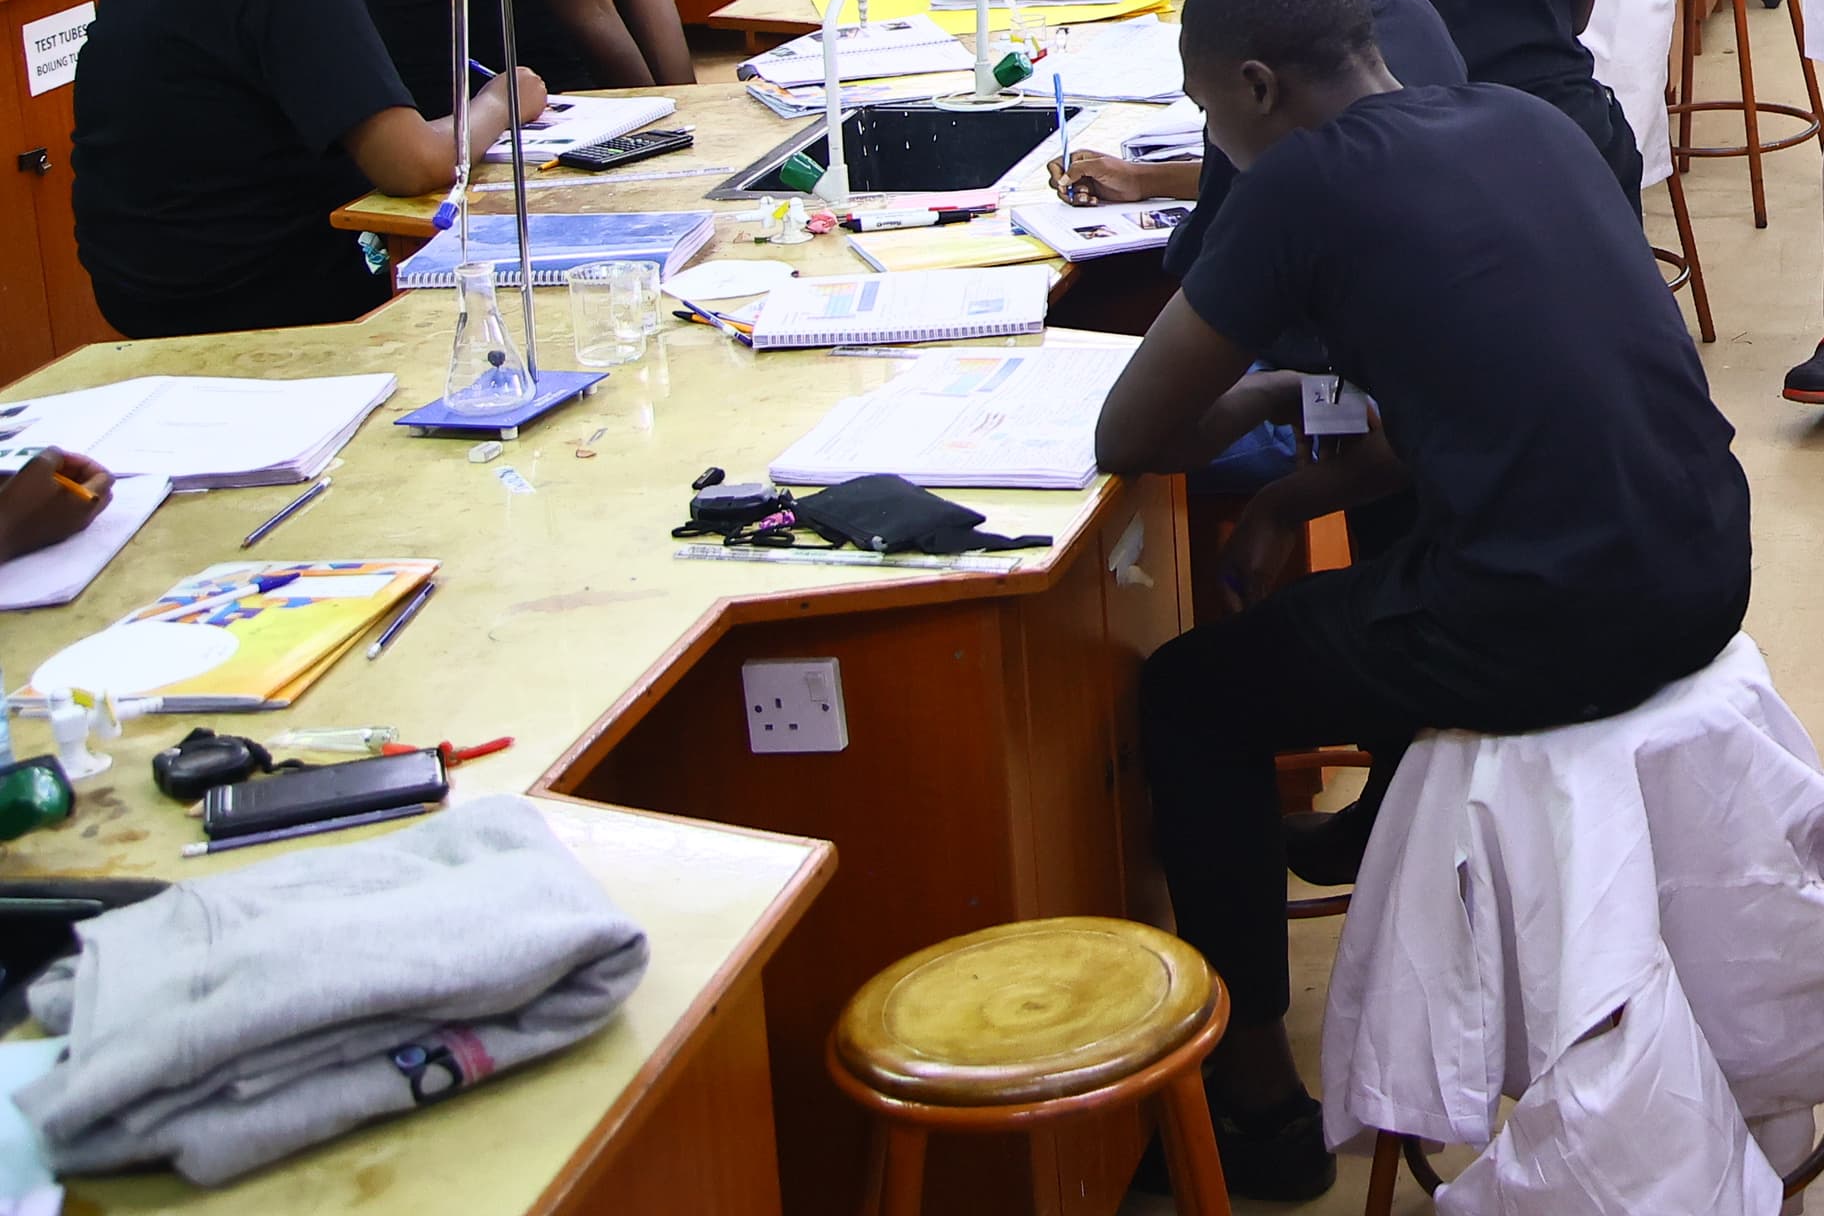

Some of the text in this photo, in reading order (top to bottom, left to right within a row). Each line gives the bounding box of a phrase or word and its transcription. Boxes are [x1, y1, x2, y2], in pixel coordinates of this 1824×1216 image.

[35, 23, 88, 54] TEST TUBES
[37, 55, 68, 77] BOILING
